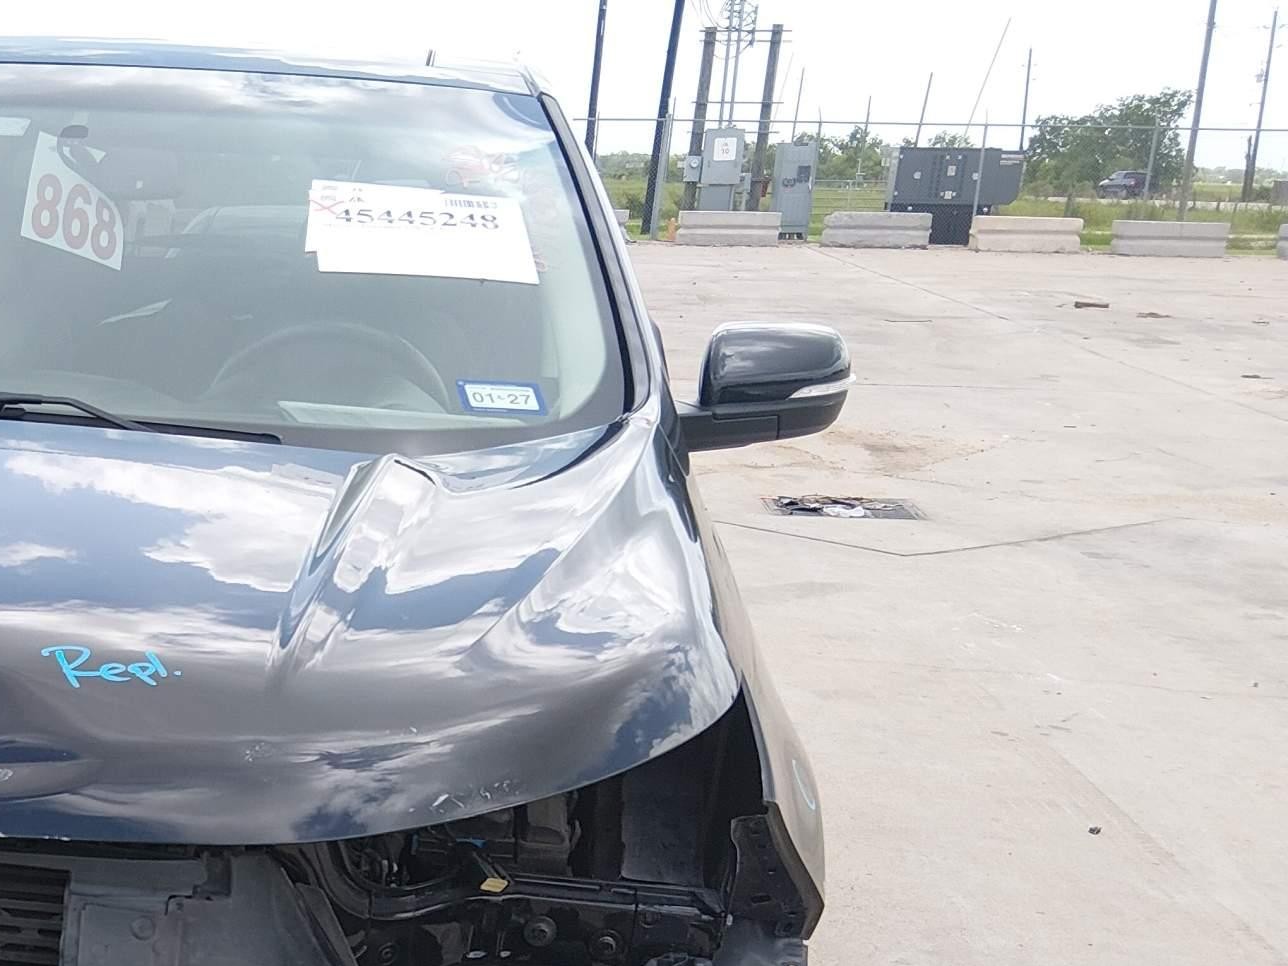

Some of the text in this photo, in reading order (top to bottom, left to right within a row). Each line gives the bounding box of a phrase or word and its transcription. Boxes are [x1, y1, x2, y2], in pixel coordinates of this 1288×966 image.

[31, 173, 117, 261] 868
[335, 207, 501, 231] 45445248
[471, 391, 531, 405] 01 27
